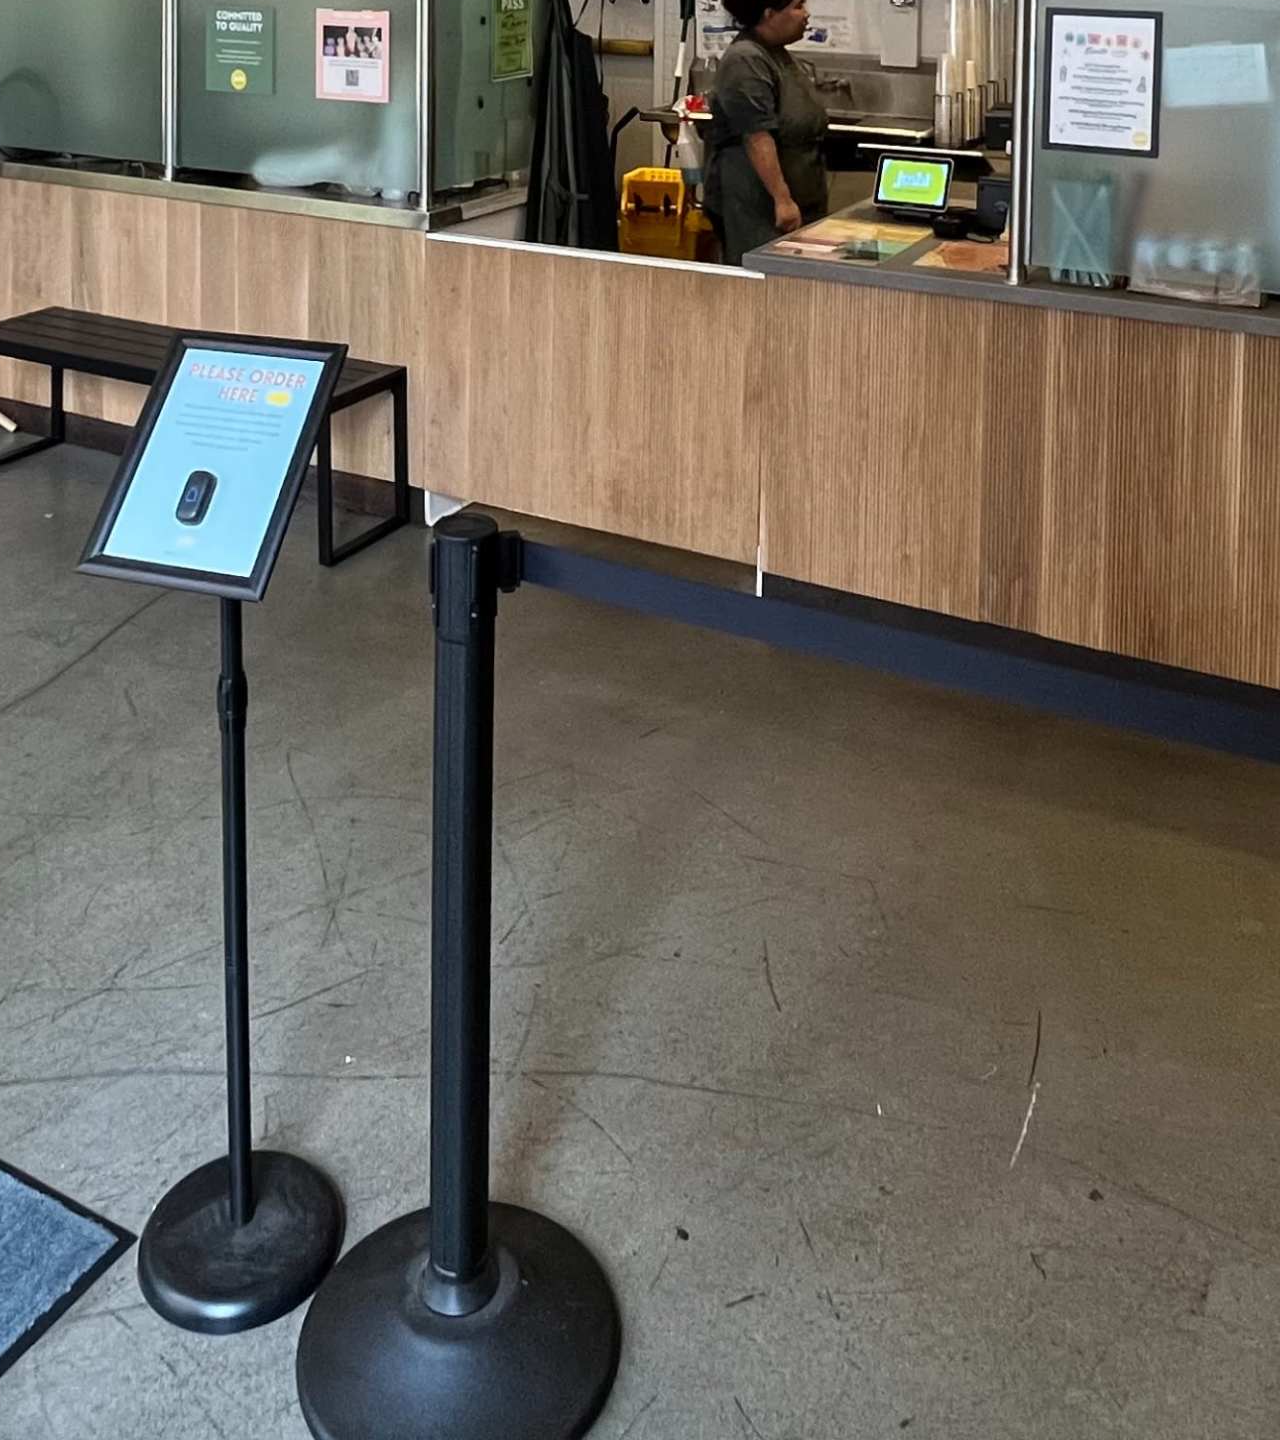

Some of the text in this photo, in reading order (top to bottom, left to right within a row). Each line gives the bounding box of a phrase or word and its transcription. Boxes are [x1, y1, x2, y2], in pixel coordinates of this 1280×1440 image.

[216, 10, 262, 22] COMMITTED
[216, 20, 263, 33] TO QUALITY
[188, 363, 307, 389] PLEASE ORDER
[217, 386, 259, 403] HERE
